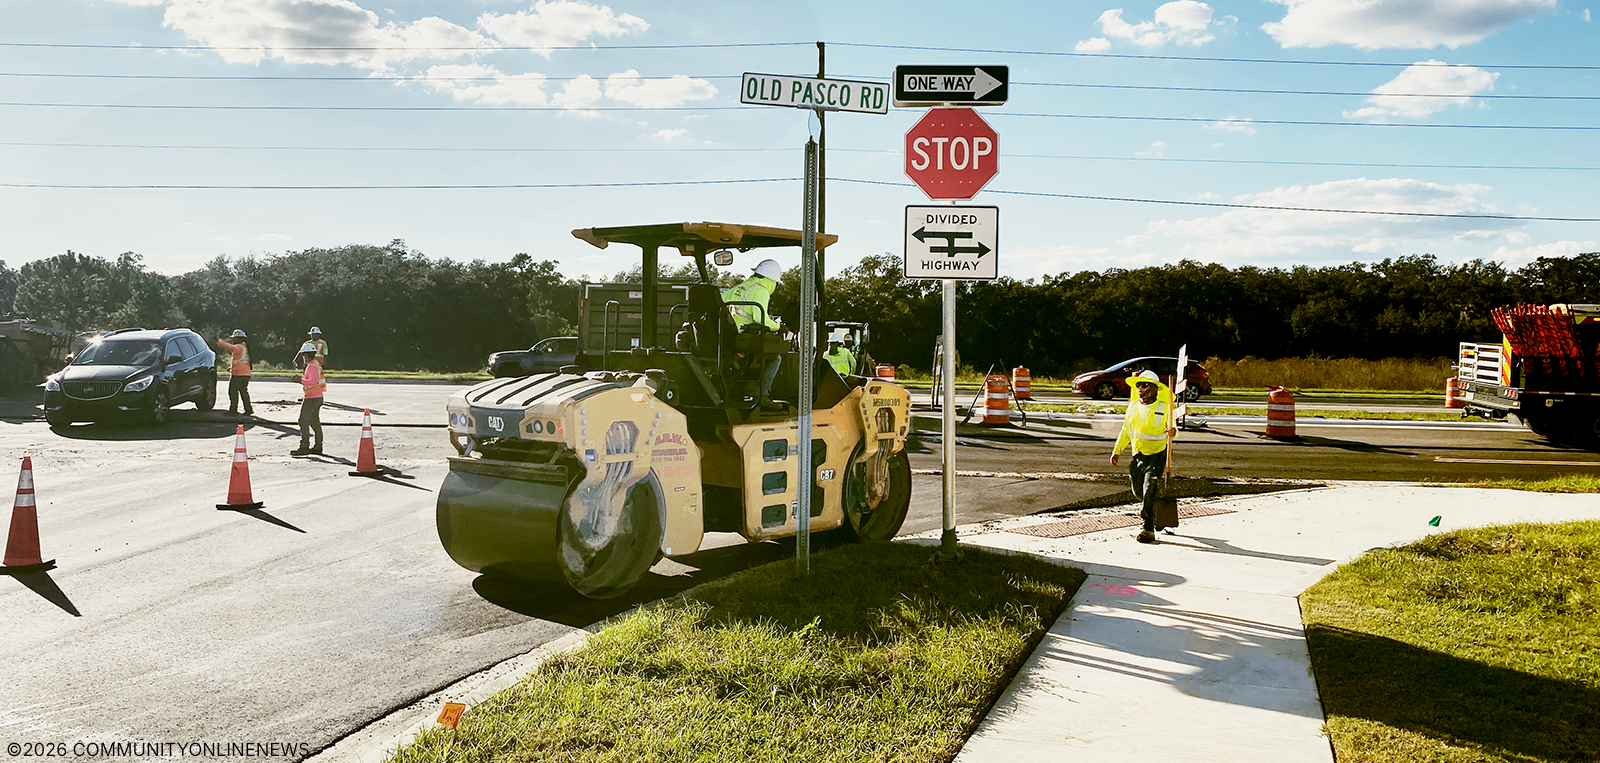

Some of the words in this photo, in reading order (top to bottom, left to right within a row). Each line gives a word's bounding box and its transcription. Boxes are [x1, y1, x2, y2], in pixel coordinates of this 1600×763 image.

[907, 76, 938, 91] ONE
[943, 76, 974, 91] WAY
[746, 77, 782, 101] OLD
[791, 83, 851, 107] PASCO
[859, 86, 885, 110] RD
[911, 136, 993, 171] STOP
[926, 214, 978, 225] DIVIDED
[921, 260, 981, 271] HIGHWAY
[488, 415, 504, 431] CAT
